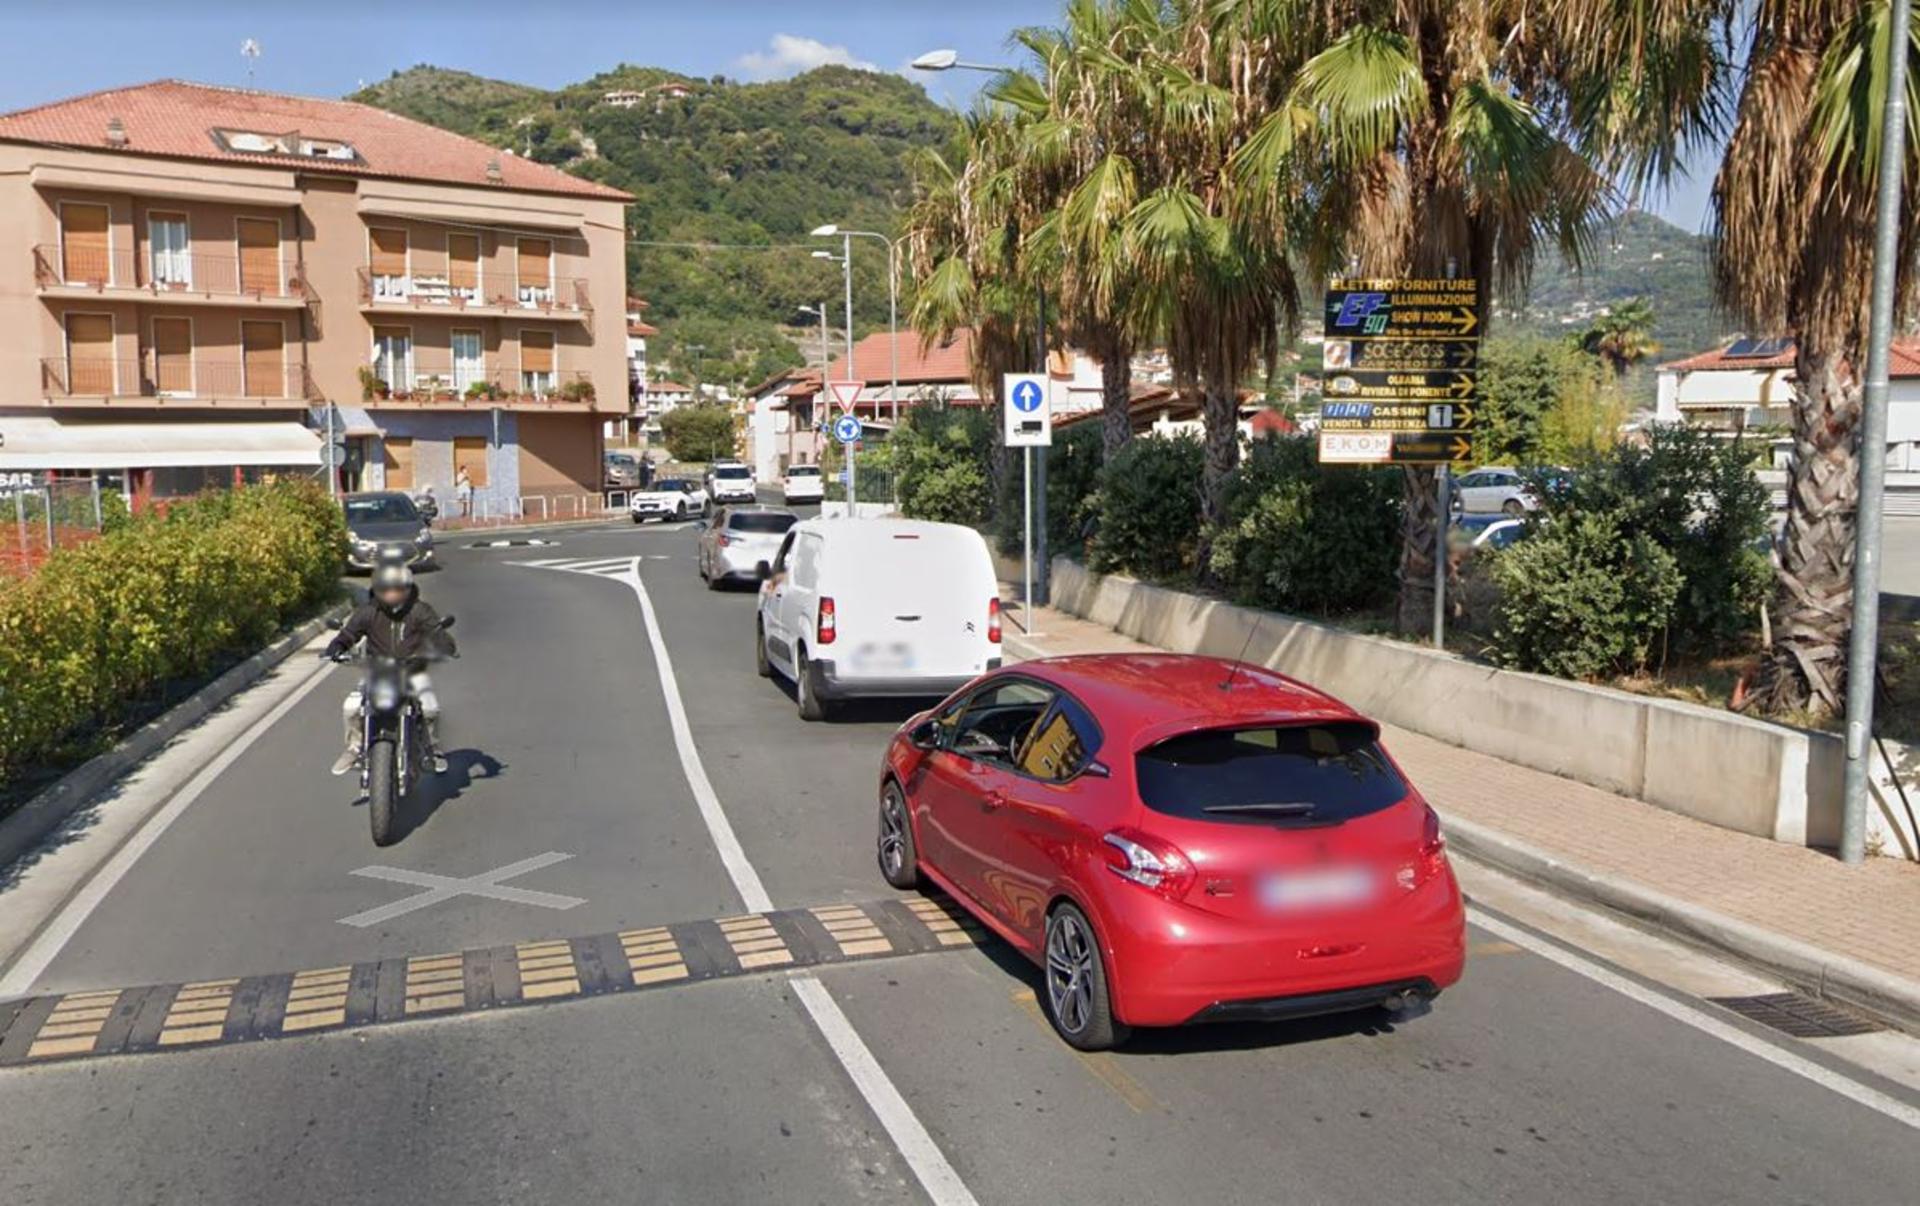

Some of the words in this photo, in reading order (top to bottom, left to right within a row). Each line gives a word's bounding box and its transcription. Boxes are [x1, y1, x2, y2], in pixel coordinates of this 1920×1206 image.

[1330, 279, 1476, 291] ELETTROFORNITURE
[1391, 294, 1476, 306] ILLUMINAZIONE
[1391, 311, 1420, 323] SHOW
[1423, 311, 1452, 323] ROOM
[1361, 387, 1397, 397] RIVIERA
[1410, 388, 1451, 398] PONENTE
[1326, 404, 1369, 416] FIAT
[1372, 406, 1426, 416] CASSINI
[1323, 420, 1363, 430] VENDITA
[1371, 420, 1427, 430] ASSISTENZA
[1326, 438, 1388, 450] EKOM
